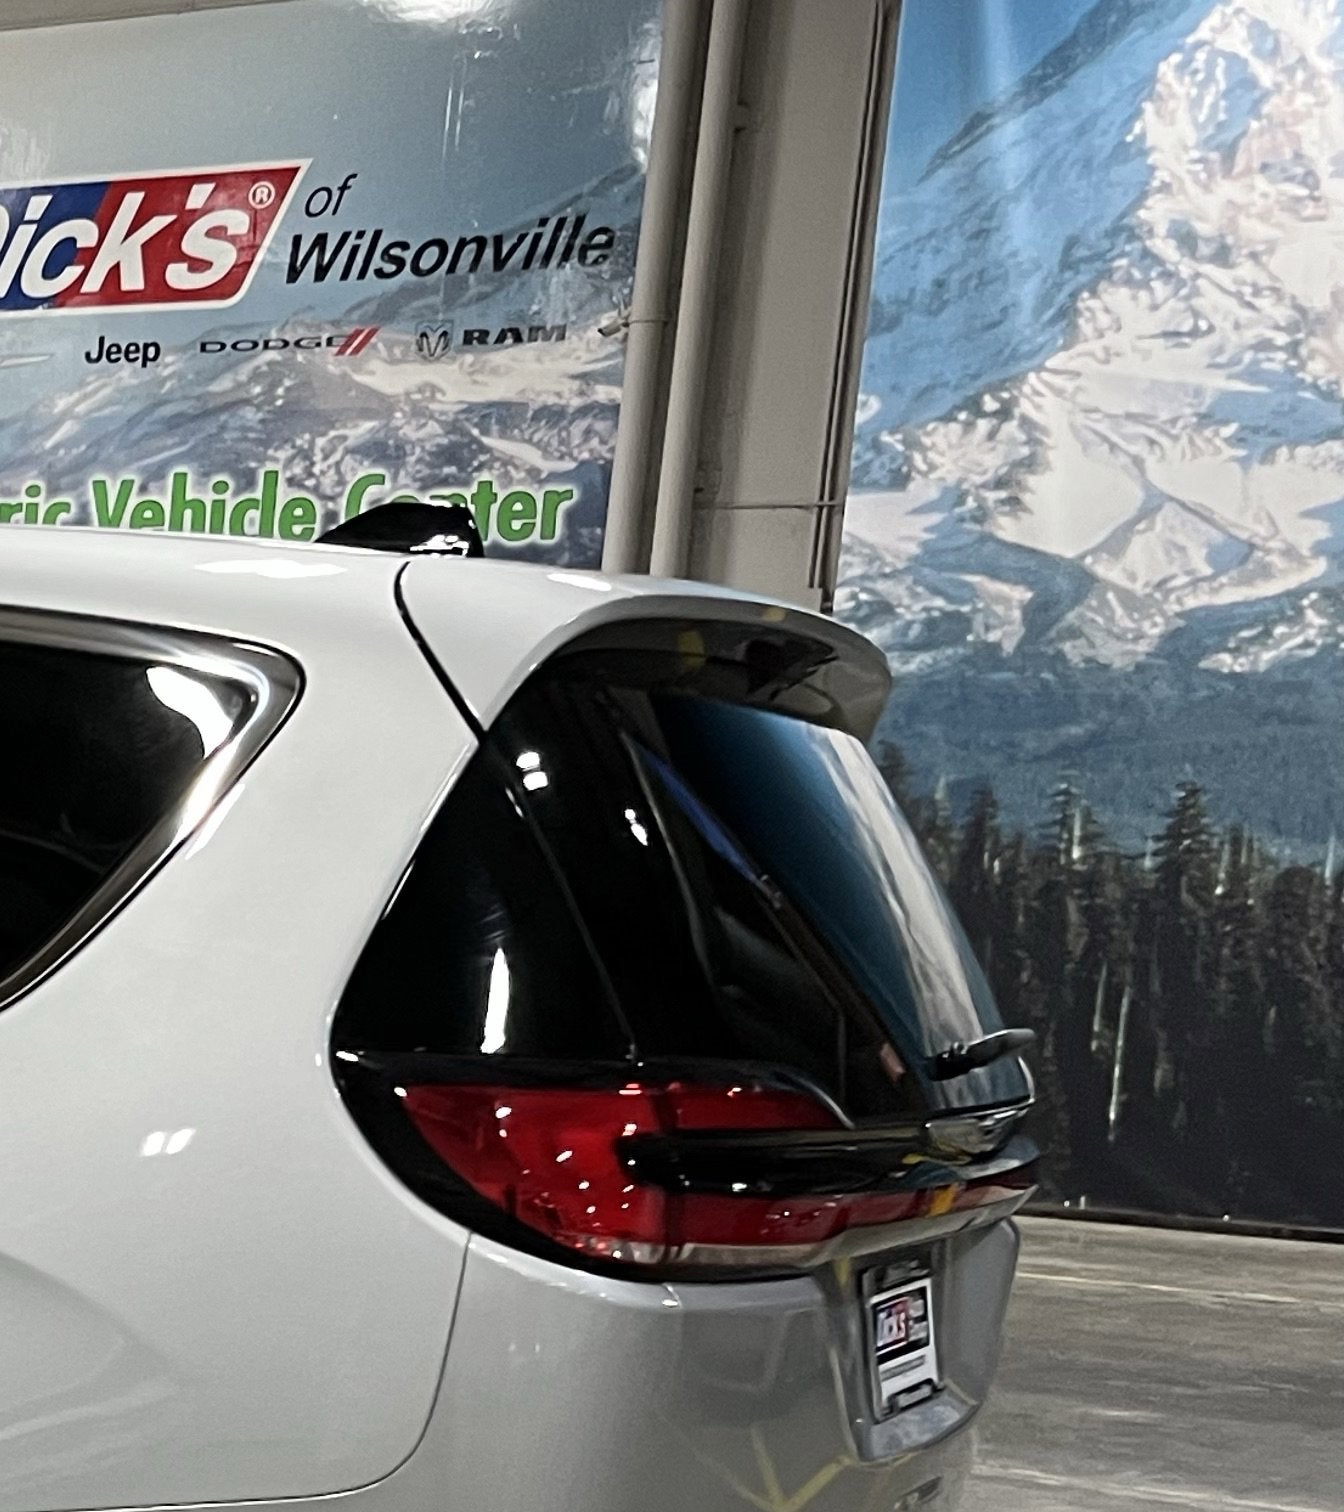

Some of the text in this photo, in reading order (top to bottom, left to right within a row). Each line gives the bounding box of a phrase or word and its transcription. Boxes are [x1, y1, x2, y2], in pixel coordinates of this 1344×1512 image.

[304, 174, 359, 219] of
[285, 213, 616, 286] Wilsonville
[84, 335, 162, 368] Jeep
[462, 325, 567, 347] RAM
[92, 470, 317, 542] Vehicle
[344, 473, 574, 542] Cter
